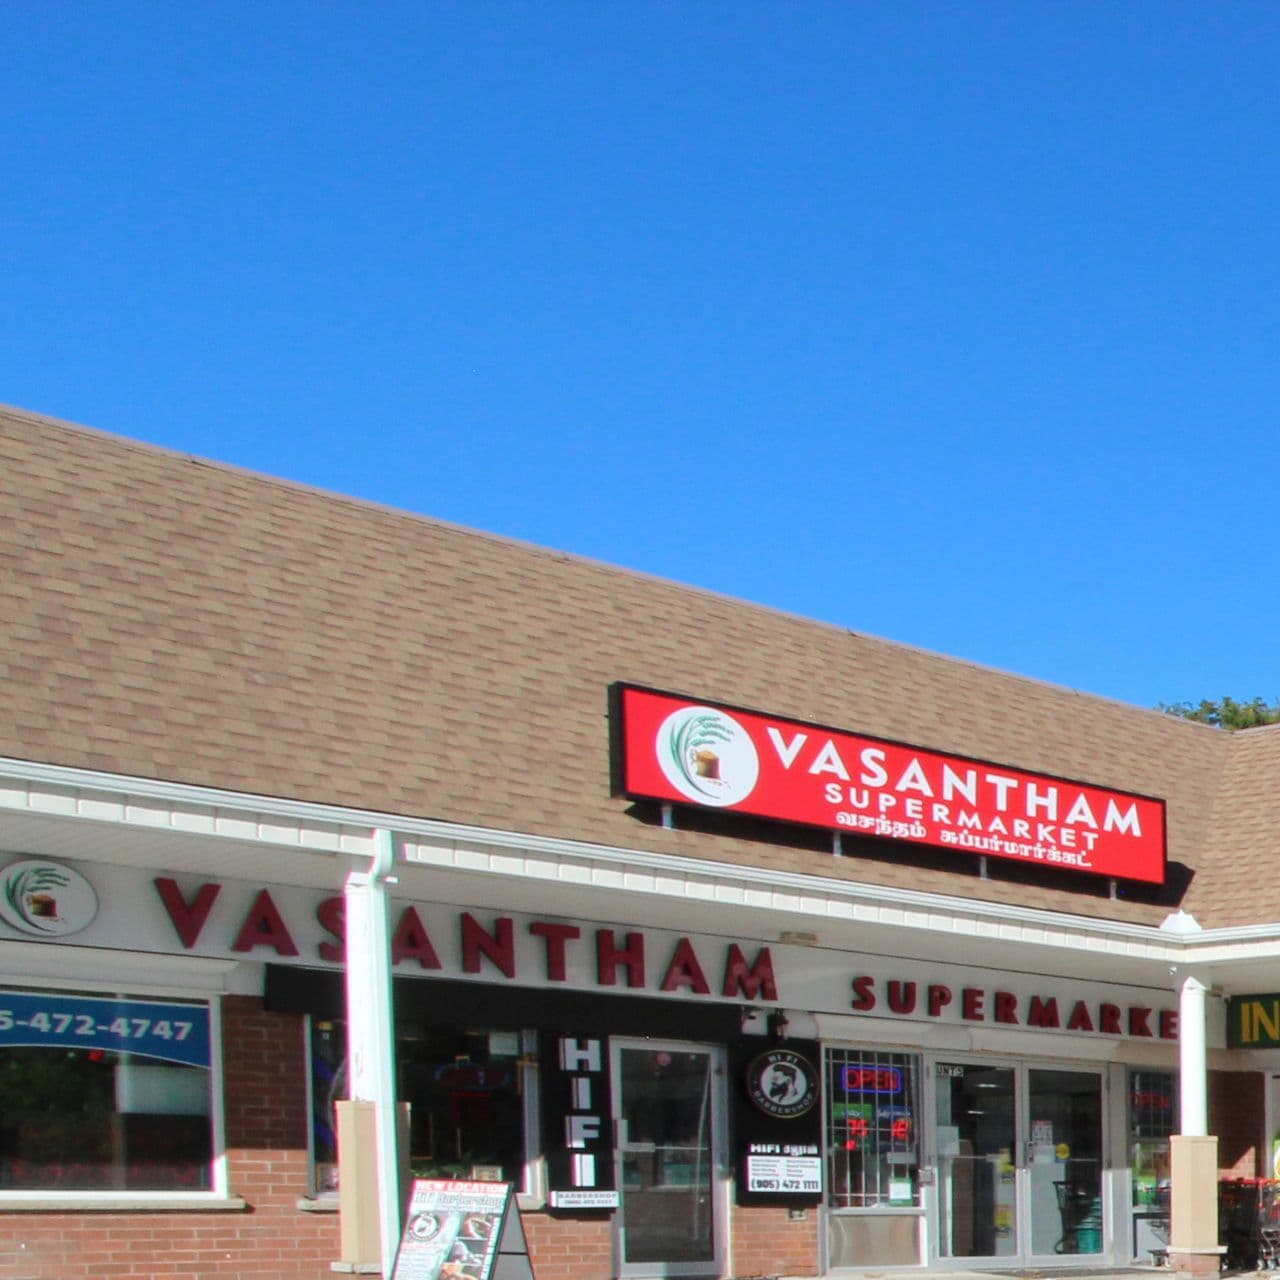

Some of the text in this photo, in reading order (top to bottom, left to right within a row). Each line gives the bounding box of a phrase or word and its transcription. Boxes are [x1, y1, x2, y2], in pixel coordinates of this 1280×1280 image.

[767, 727, 1142, 837] VASANTHAM
[825, 782, 1098, 851] SUPERMARKET
[154, 877, 778, 1001] VASANTHAM
[851, 975, 1180, 1039] SUPERMARKE
[847, 1069, 899, 1089] OPEN
[750, 1144, 780, 1154] HIFI
[447, 1183, 508, 1193] LOCATION
[751, 1179, 780, 1190] (905)
[782, 1180, 801, 1190] 472
